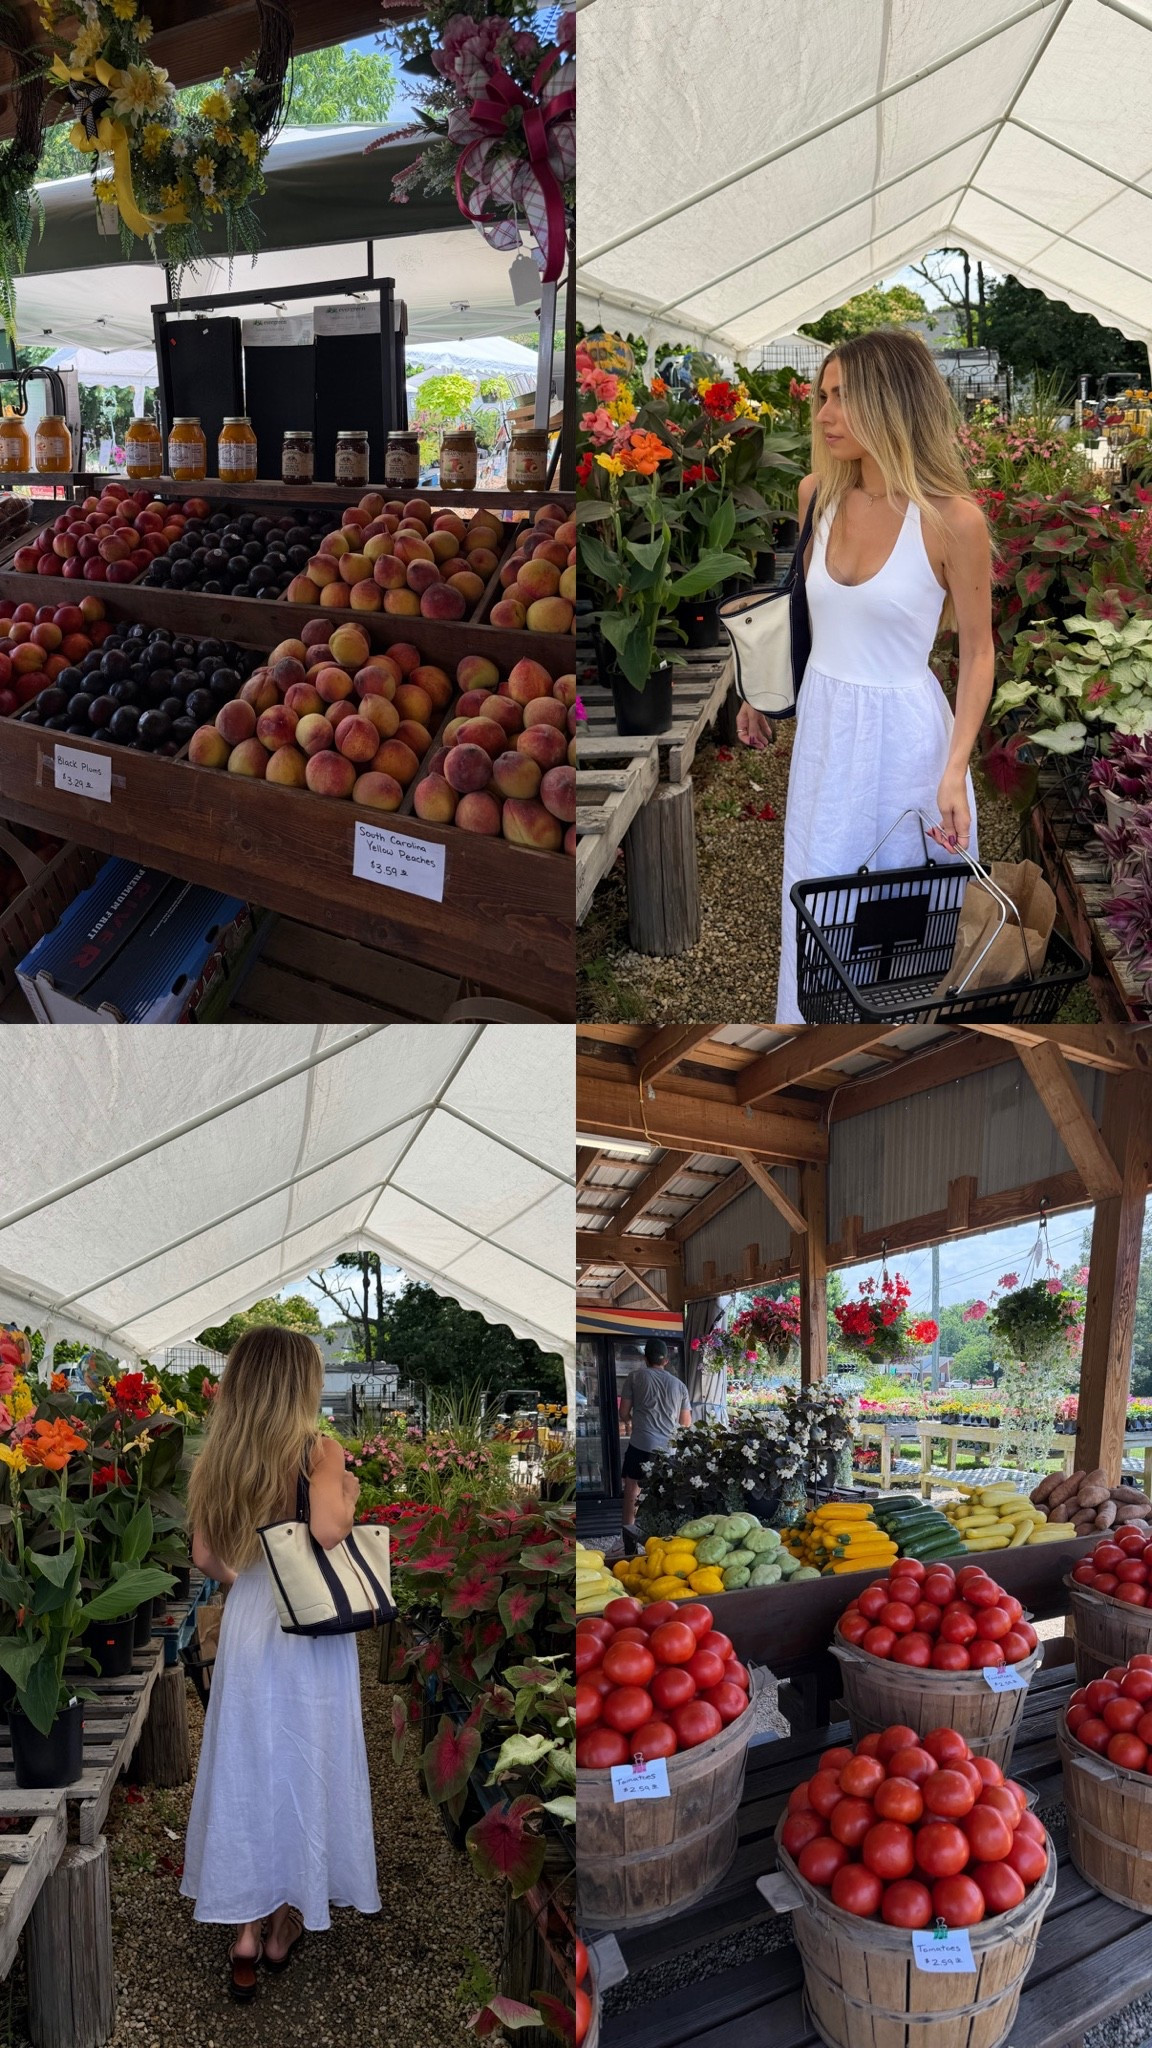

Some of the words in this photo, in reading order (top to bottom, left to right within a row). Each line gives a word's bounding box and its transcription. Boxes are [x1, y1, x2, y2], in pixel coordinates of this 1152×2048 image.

[57, 755, 78, 769] Black
[81, 762, 102, 776] Plums
[62, 773, 84, 789] $3.29
[359, 826, 386, 842] South
[390, 835, 427, 853] Carolina
[366, 840, 394, 856] Yellow
[398, 849, 436, 868] Peaches
[370, 860, 398, 877] $3.59
[111, 868, 146, 911] PREMIUM
[87, 909, 114, 940] FRUIT
[616, 1773, 657, 1786] Tomatoes
[916, 1944, 961, 1953] Tomatoes
